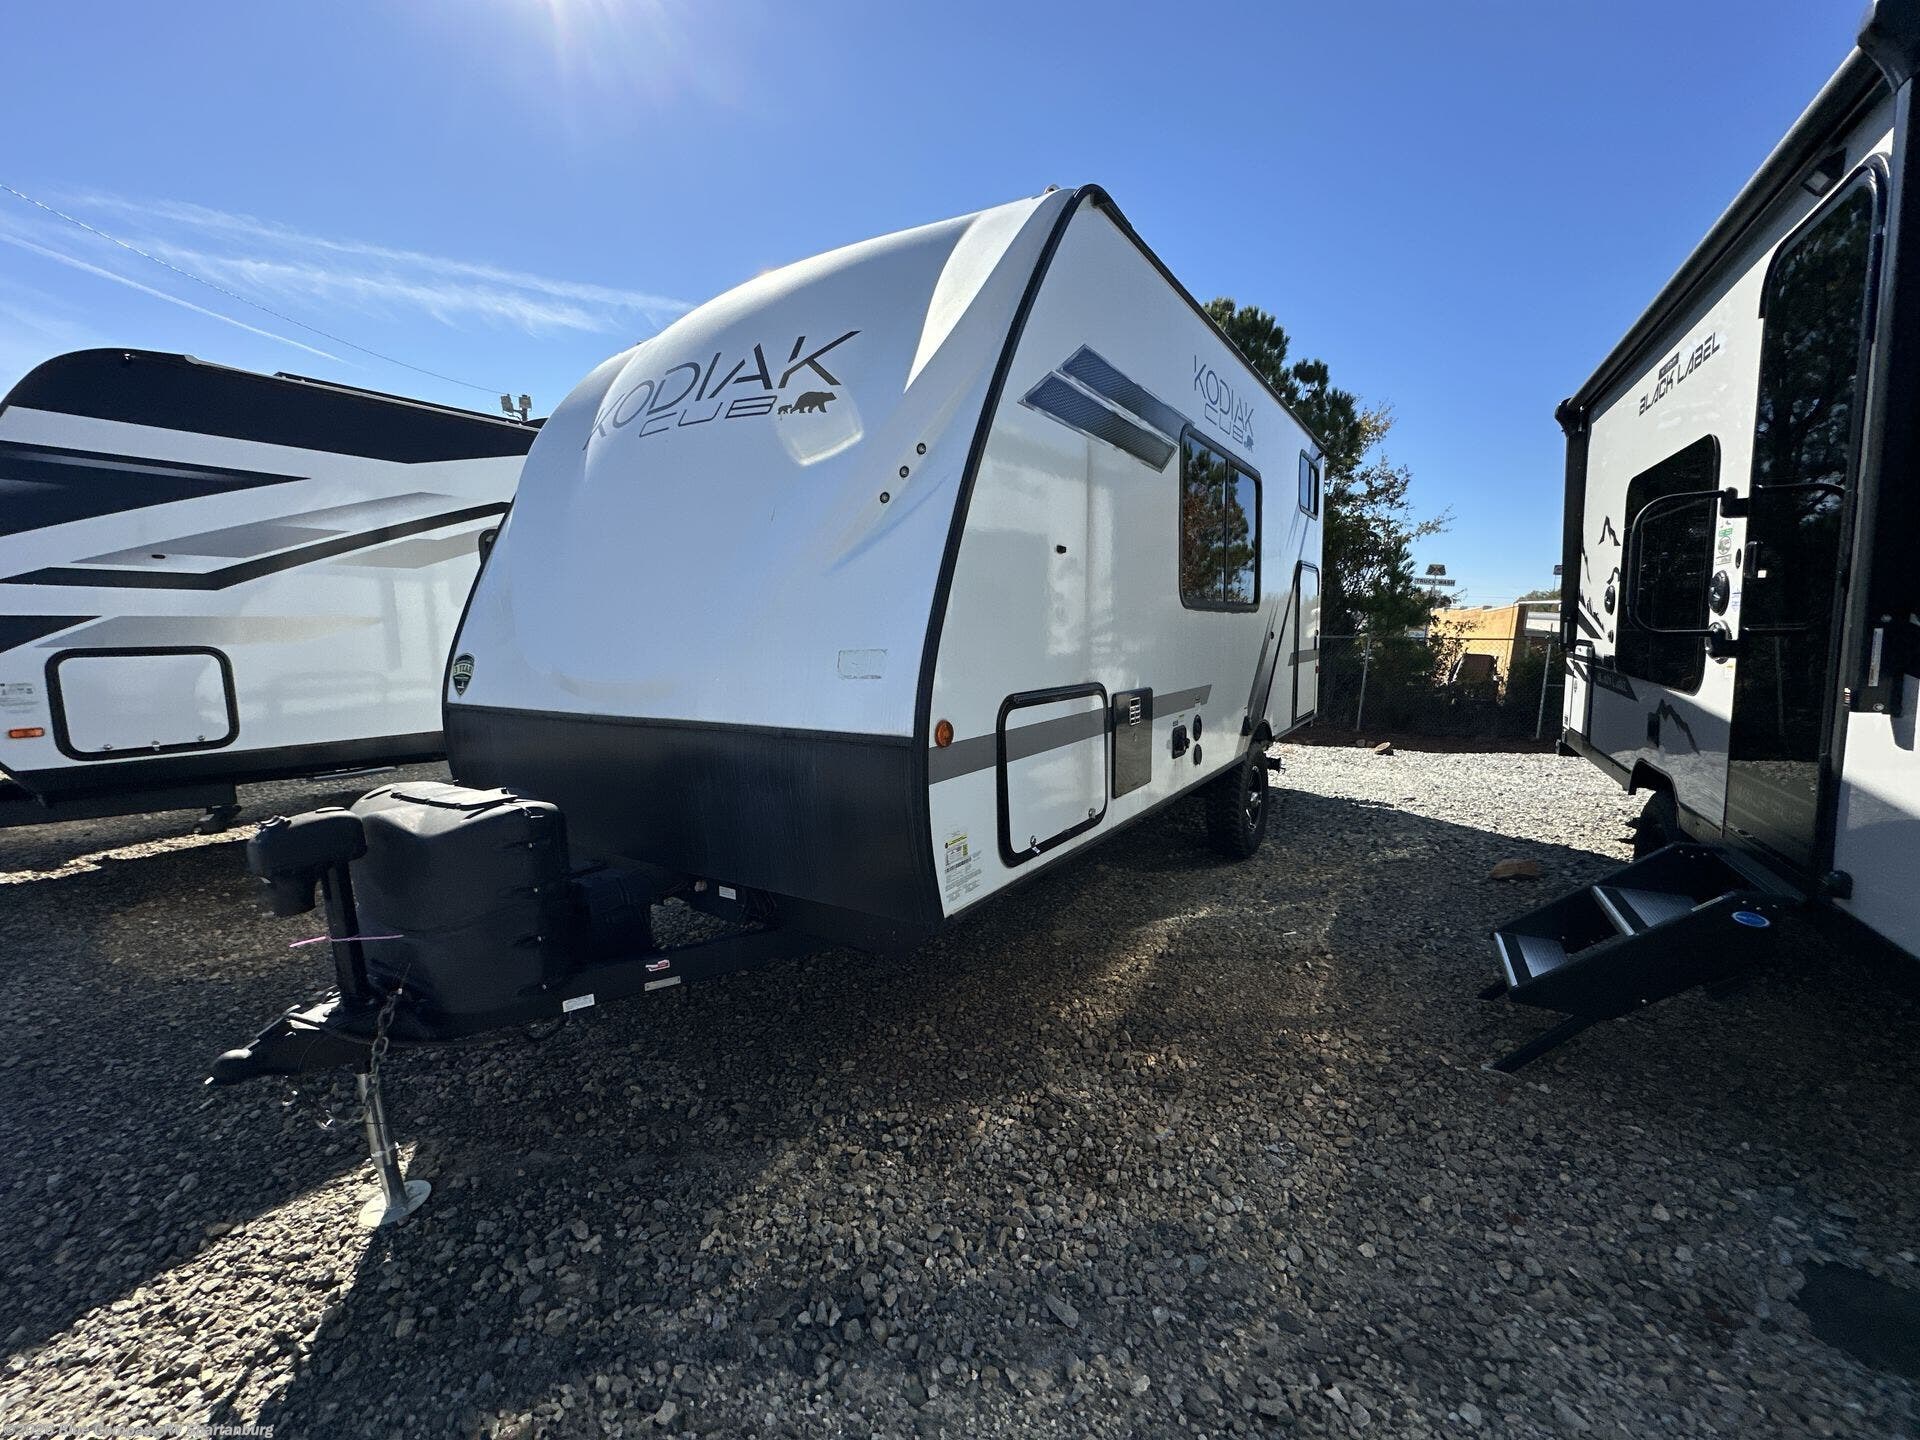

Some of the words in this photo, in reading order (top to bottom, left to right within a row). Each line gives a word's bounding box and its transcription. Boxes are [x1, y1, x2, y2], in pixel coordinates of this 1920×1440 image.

[582, 330, 862, 451] KODIAK
[1193, 355, 1254, 437] KODIAK
[1639, 370, 1675, 417] BLACK
[1677, 332, 1720, 384] LABEL
[639, 395, 777, 438] CUB
[1204, 403, 1244, 445] CUB
